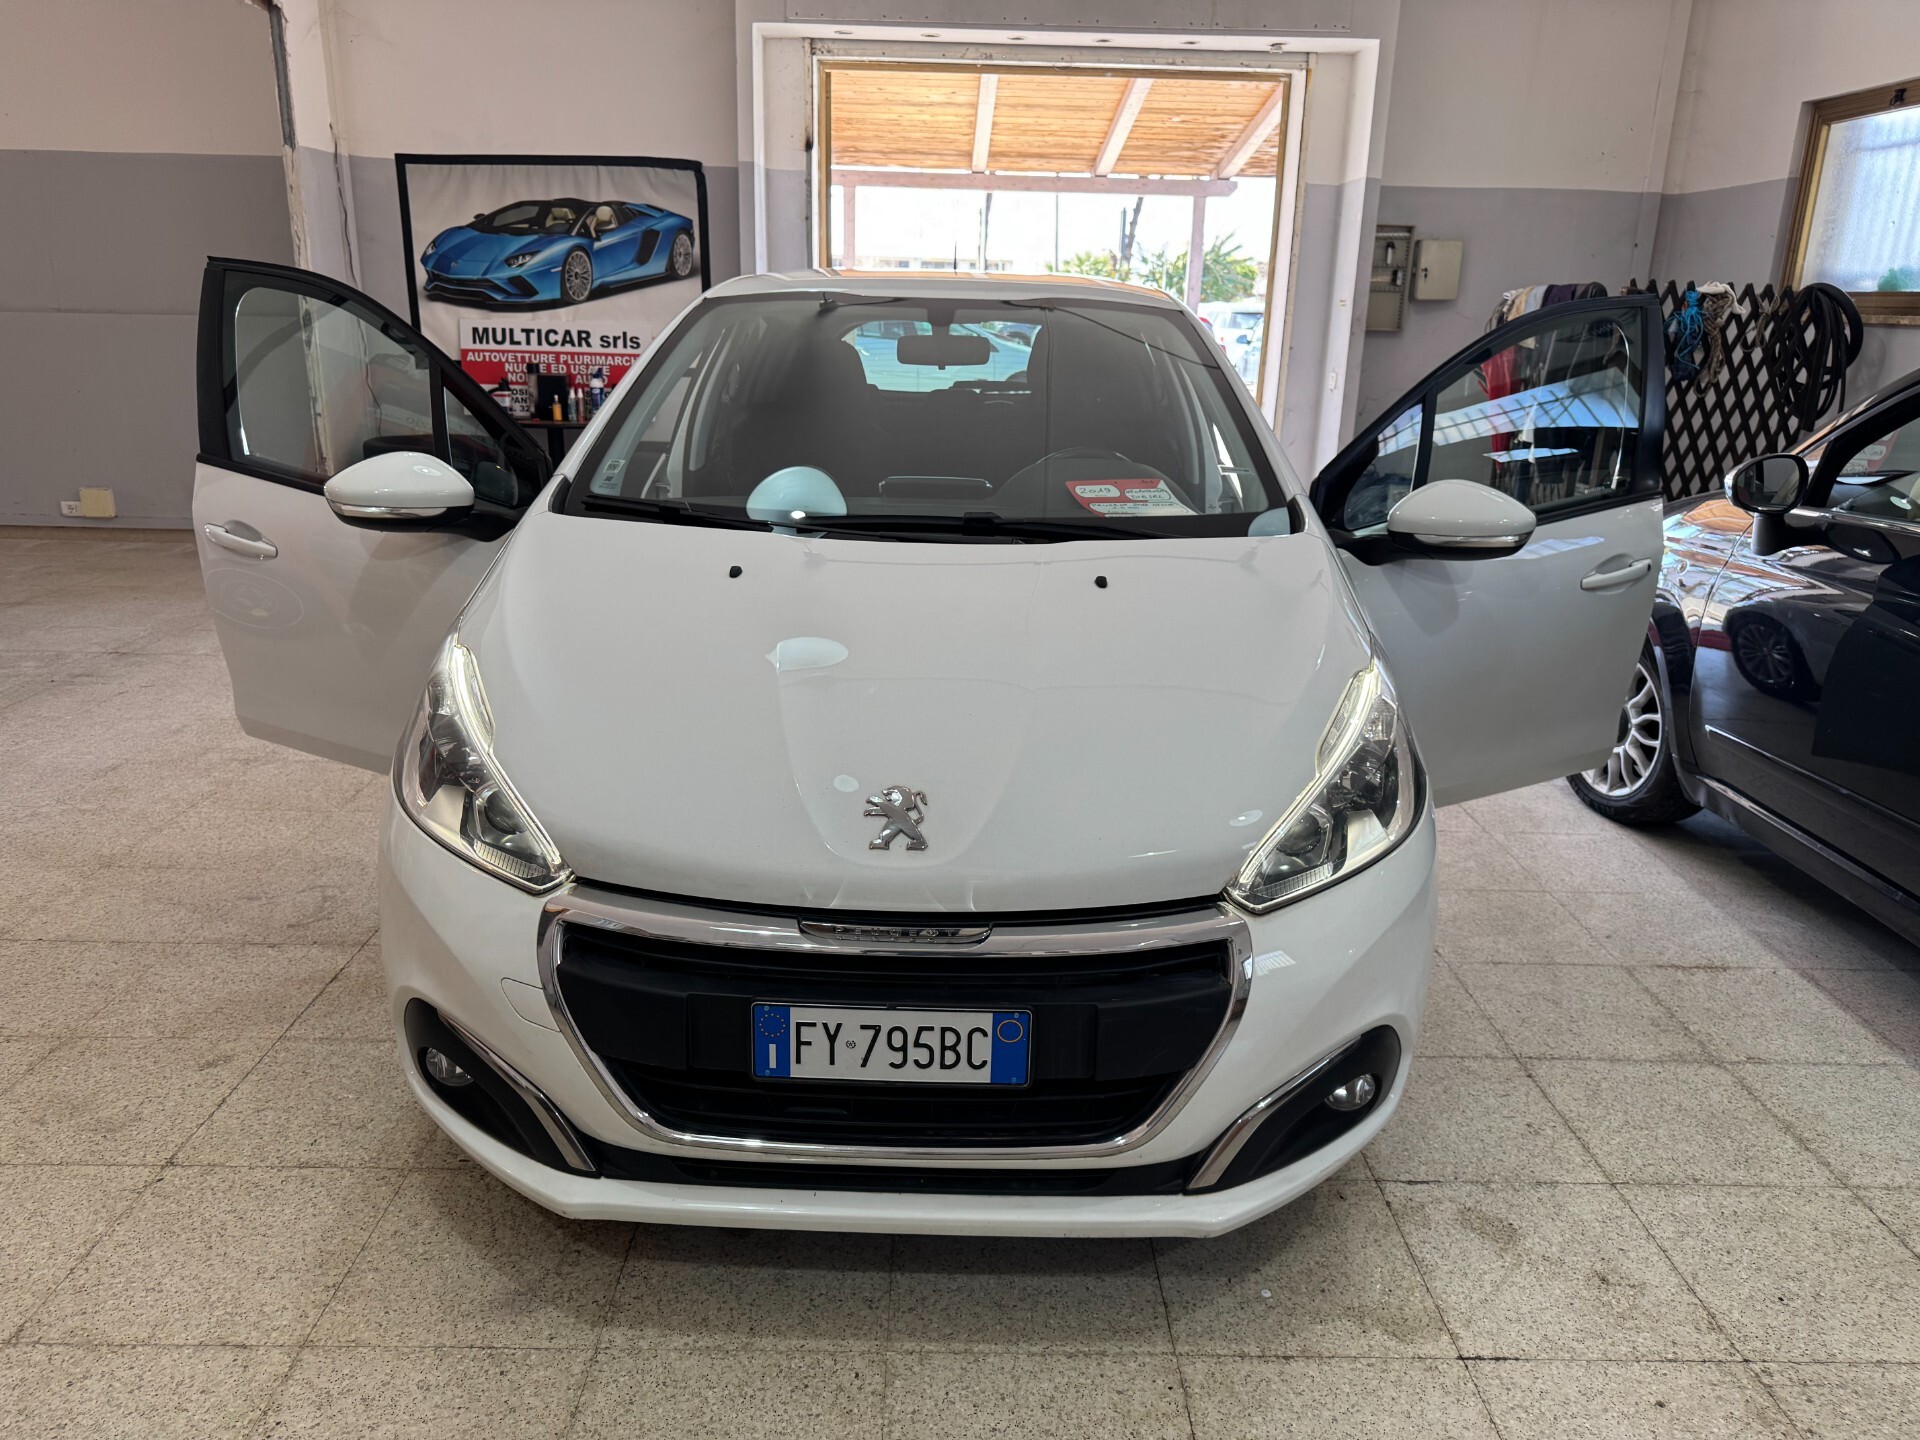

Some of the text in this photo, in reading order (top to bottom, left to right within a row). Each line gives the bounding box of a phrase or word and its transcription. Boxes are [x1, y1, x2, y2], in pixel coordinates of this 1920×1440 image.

[472, 327, 641, 349] MULTICAR srls
[466, 351, 556, 364] AUTOVETTURE
[551, 364, 567, 374] ED
[835, 926, 954, 937] PEUGEOT
[795, 1021, 989, 1070] FY 795BC
